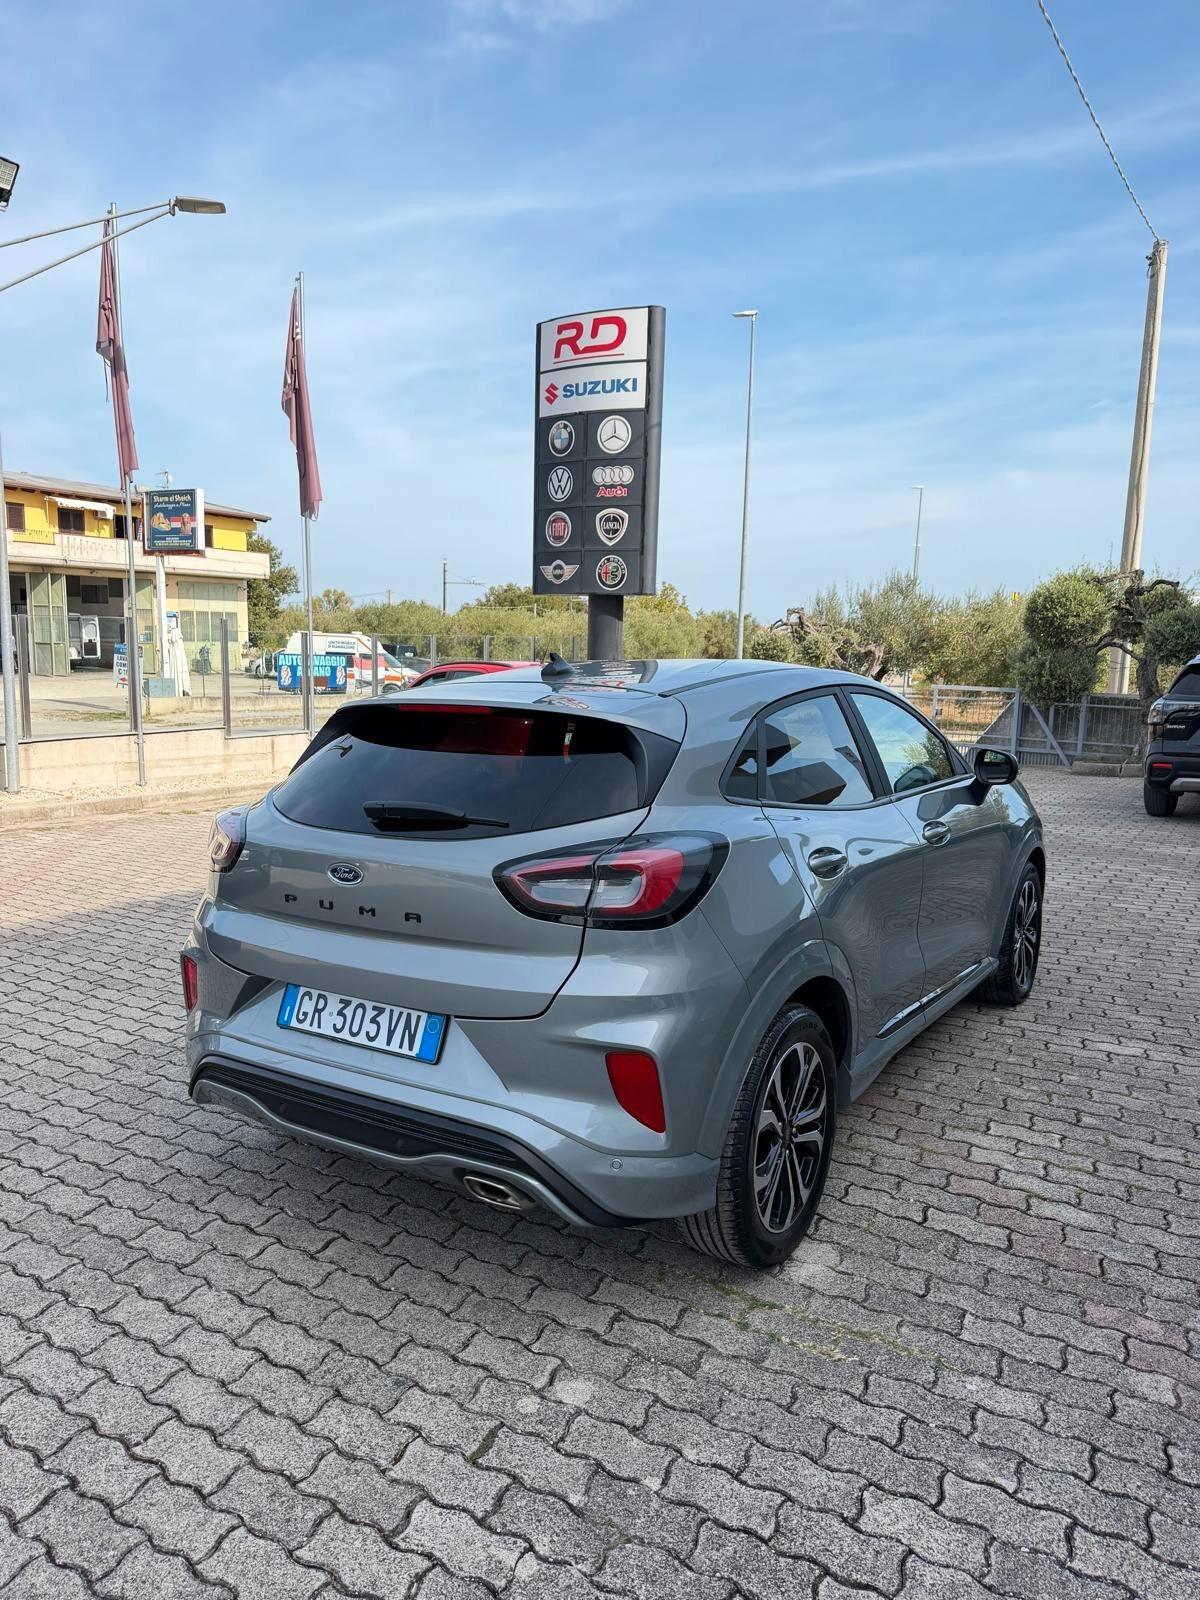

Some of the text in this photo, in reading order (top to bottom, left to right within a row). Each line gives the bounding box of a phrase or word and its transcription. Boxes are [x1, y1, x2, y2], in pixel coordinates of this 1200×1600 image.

[554, 316, 627, 359] RD
[562, 377, 638, 399] SUZUKI
[596, 486, 629, 497] Audi
[552, 522, 565, 537] FIAT
[603, 521, 620, 530] LANCIA
[279, 655, 346, 667] AUTOVAGGIO
[334, 867, 355, 880] Ford
[284, 894, 422, 924] PUMA
[295, 990, 328, 1029] GR
[332, 998, 422, 1052] 303VN
